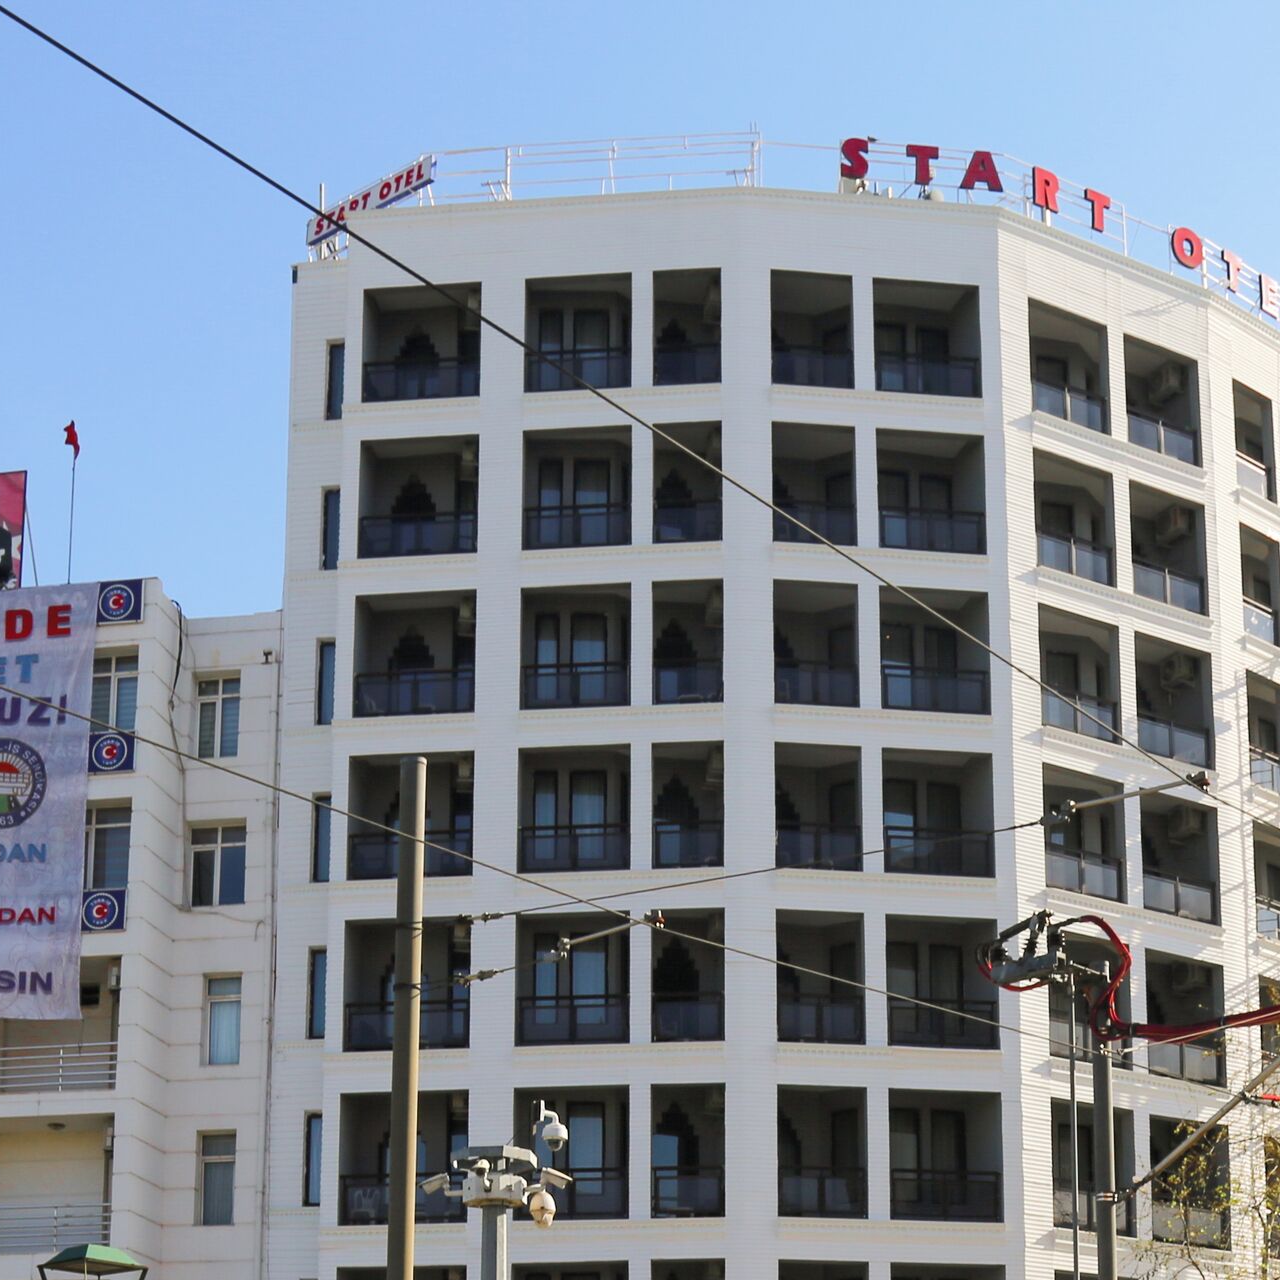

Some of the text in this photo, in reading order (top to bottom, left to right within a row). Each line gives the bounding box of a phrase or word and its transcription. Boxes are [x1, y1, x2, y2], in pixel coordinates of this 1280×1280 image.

[314, 163, 424, 236] START OTEL
[840, 137, 1111, 234] START
